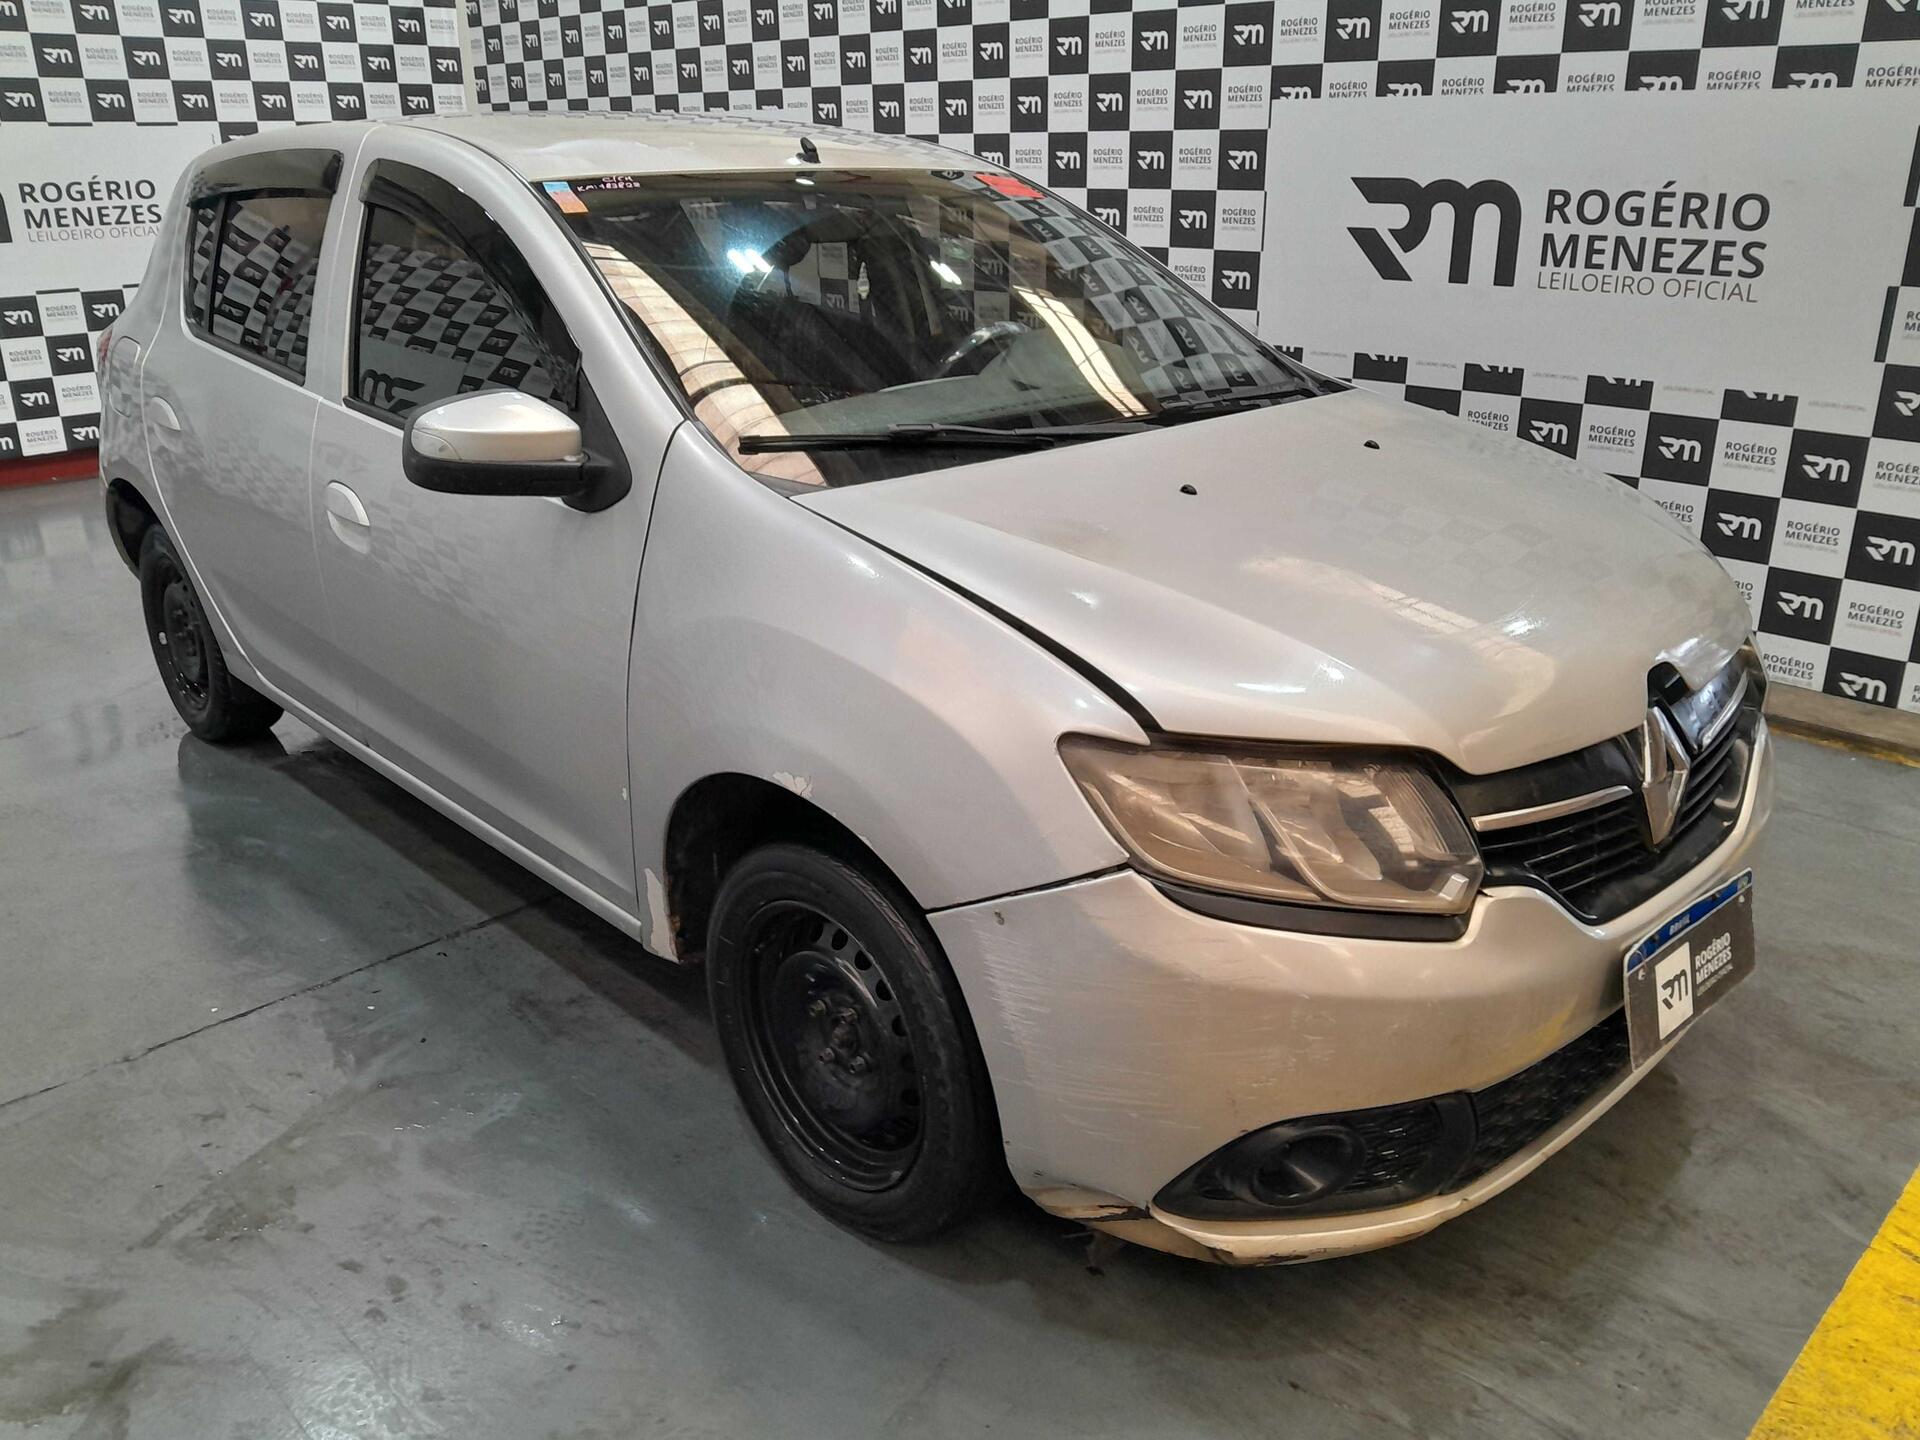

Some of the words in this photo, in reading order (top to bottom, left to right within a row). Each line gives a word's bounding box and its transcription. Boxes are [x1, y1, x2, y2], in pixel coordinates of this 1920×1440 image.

[1510, 2, 1556, 13] ROGÉRIO
[1644, 5, 1695, 16] MENEZES
[1390, 10, 1430, 20] ROGÉRIO
[1509, 13, 1555, 23] MENEZES
[1281, 17, 1318, 27] ROGÉRIO
[1389, 20, 1430, 30] MENEZES
[1183, 24, 1216, 33] ROGÉRIO
[1281, 27, 1317, 36] MENEZES
[1095, 30, 1125, 39] ROGÉRIO
[1183, 33, 1216, 42] MENEZES
[1095, 39, 1125, 47] MENEZES
[1568, 73, 1615, 83] ROGÉRIO
[1708, 70, 1761, 80] ROGÉRIO
[1329, 81, 1367, 90] ROGÉRIO
[1442, 77, 1484, 87] ROGÉRIO
[1228, 85, 1262, 93] ROGÉRIO
[1054, 91, 1082, 99] ROGÉRIO
[1228, 94, 1262, 102] MENEZES
[1137, 97, 1168, 105] MENEZES
[1093, 148, 1123, 156] ROGÉRIO
[1179, 156, 1211, 164] MENEZES
[18, 175, 156, 204] ROGÉRIO
[1133, 206, 1164, 214] ROGÉRIO
[1544, 180, 1770, 231] ROGÉRIO
[23, 204, 162, 229] MENEZES
[1223, 208, 1256, 216] ROGÉRIO
[1133, 214, 1164, 222] MENEZES
[1222, 217, 1255, 226] MENEZES
[28, 228, 105, 243] LEILOEIRO
[1540, 233, 1767, 279] MENEZES
[1175, 265, 1206, 273] ROGÉRIO
[1537, 271, 1654, 296] LEILOEIRO
[1662, 277, 1758, 303] OFICIAL
[1468, 410, 1509, 422] ROGÉRIO
[1590, 425, 1636, 438] ROGÉRIO
[1589, 434, 1635, 447] MENEZES
[1726, 442, 1777, 455] ROGÉRIO
[1724, 451, 1776, 465] MENEZES
[1787, 521, 1840, 536] ROGÉRIO
[1785, 530, 1838, 547] MENEZES
[1850, 602, 1904, 619] ROGÉRIO
[1848, 611, 1902, 629] MENEZES
[1763, 653, 1814, 670] ROGÉRIO
[1695, 932, 1731, 970] ROGÉRIO
[1696, 946, 1732, 985] MENEZES
